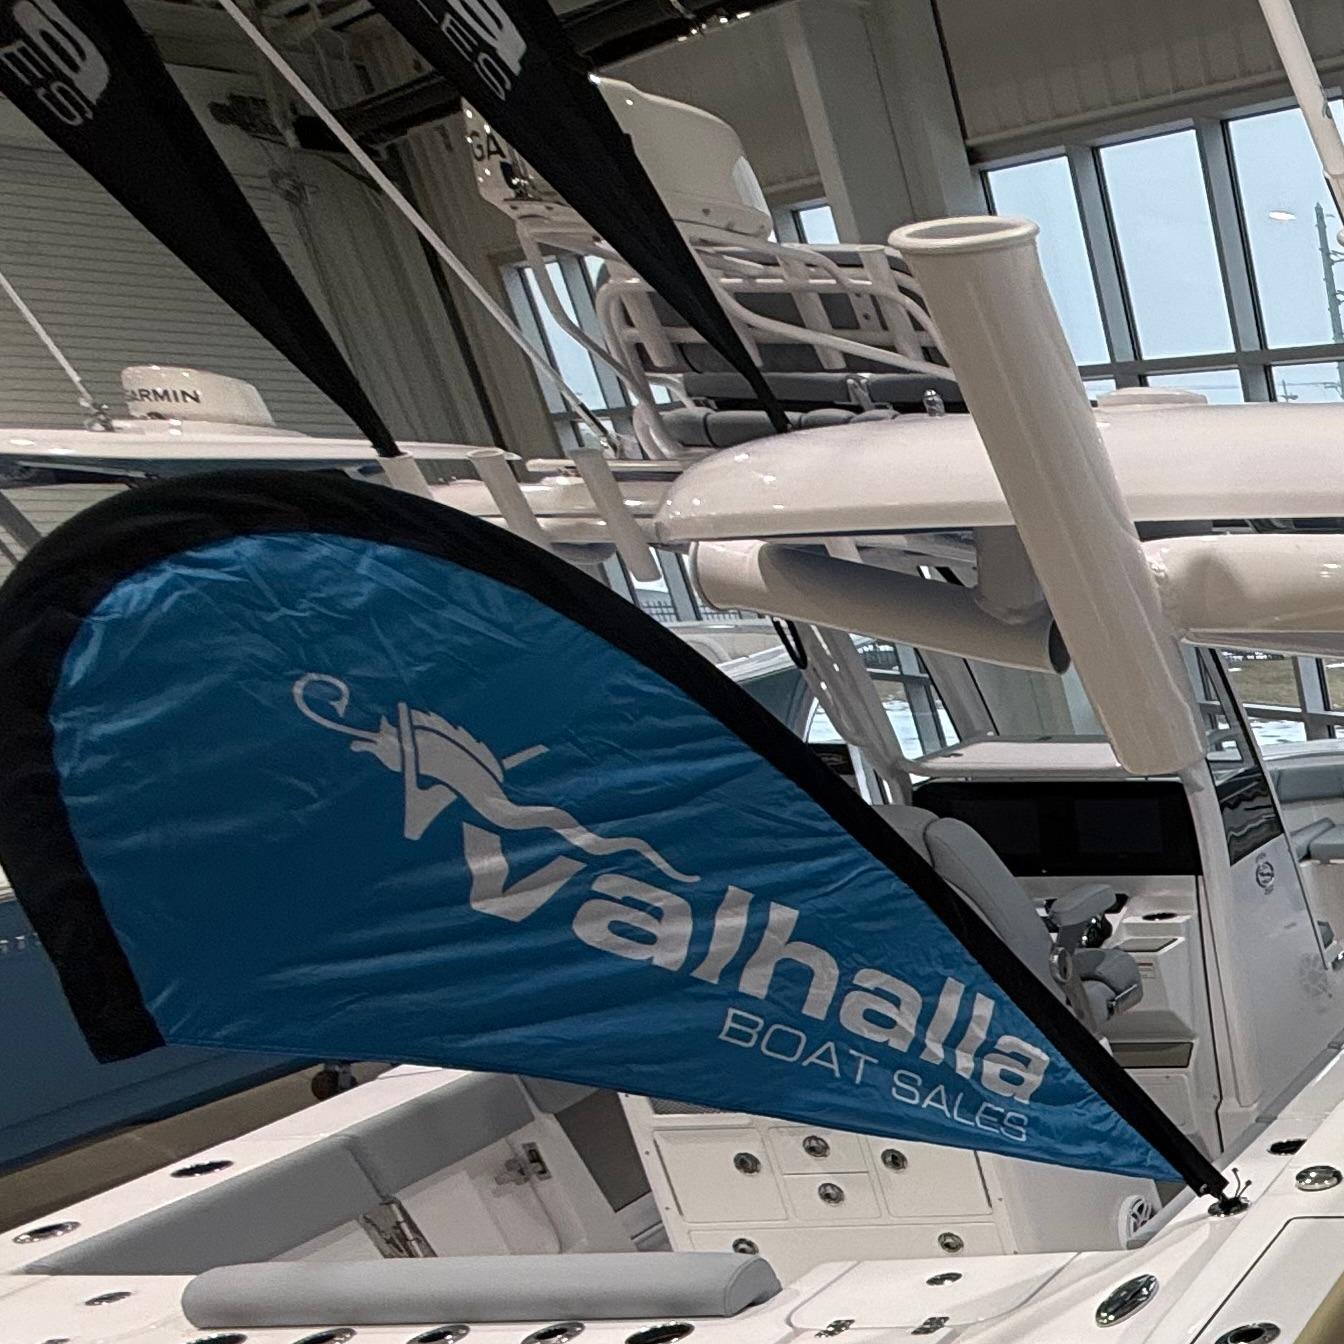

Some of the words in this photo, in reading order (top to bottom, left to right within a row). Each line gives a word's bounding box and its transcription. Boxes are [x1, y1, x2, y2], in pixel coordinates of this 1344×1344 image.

[461, 821, 1051, 1106] Valhalla
[717, 1006, 878, 1085] BOAT
[891, 1068, 1029, 1143] SALES
